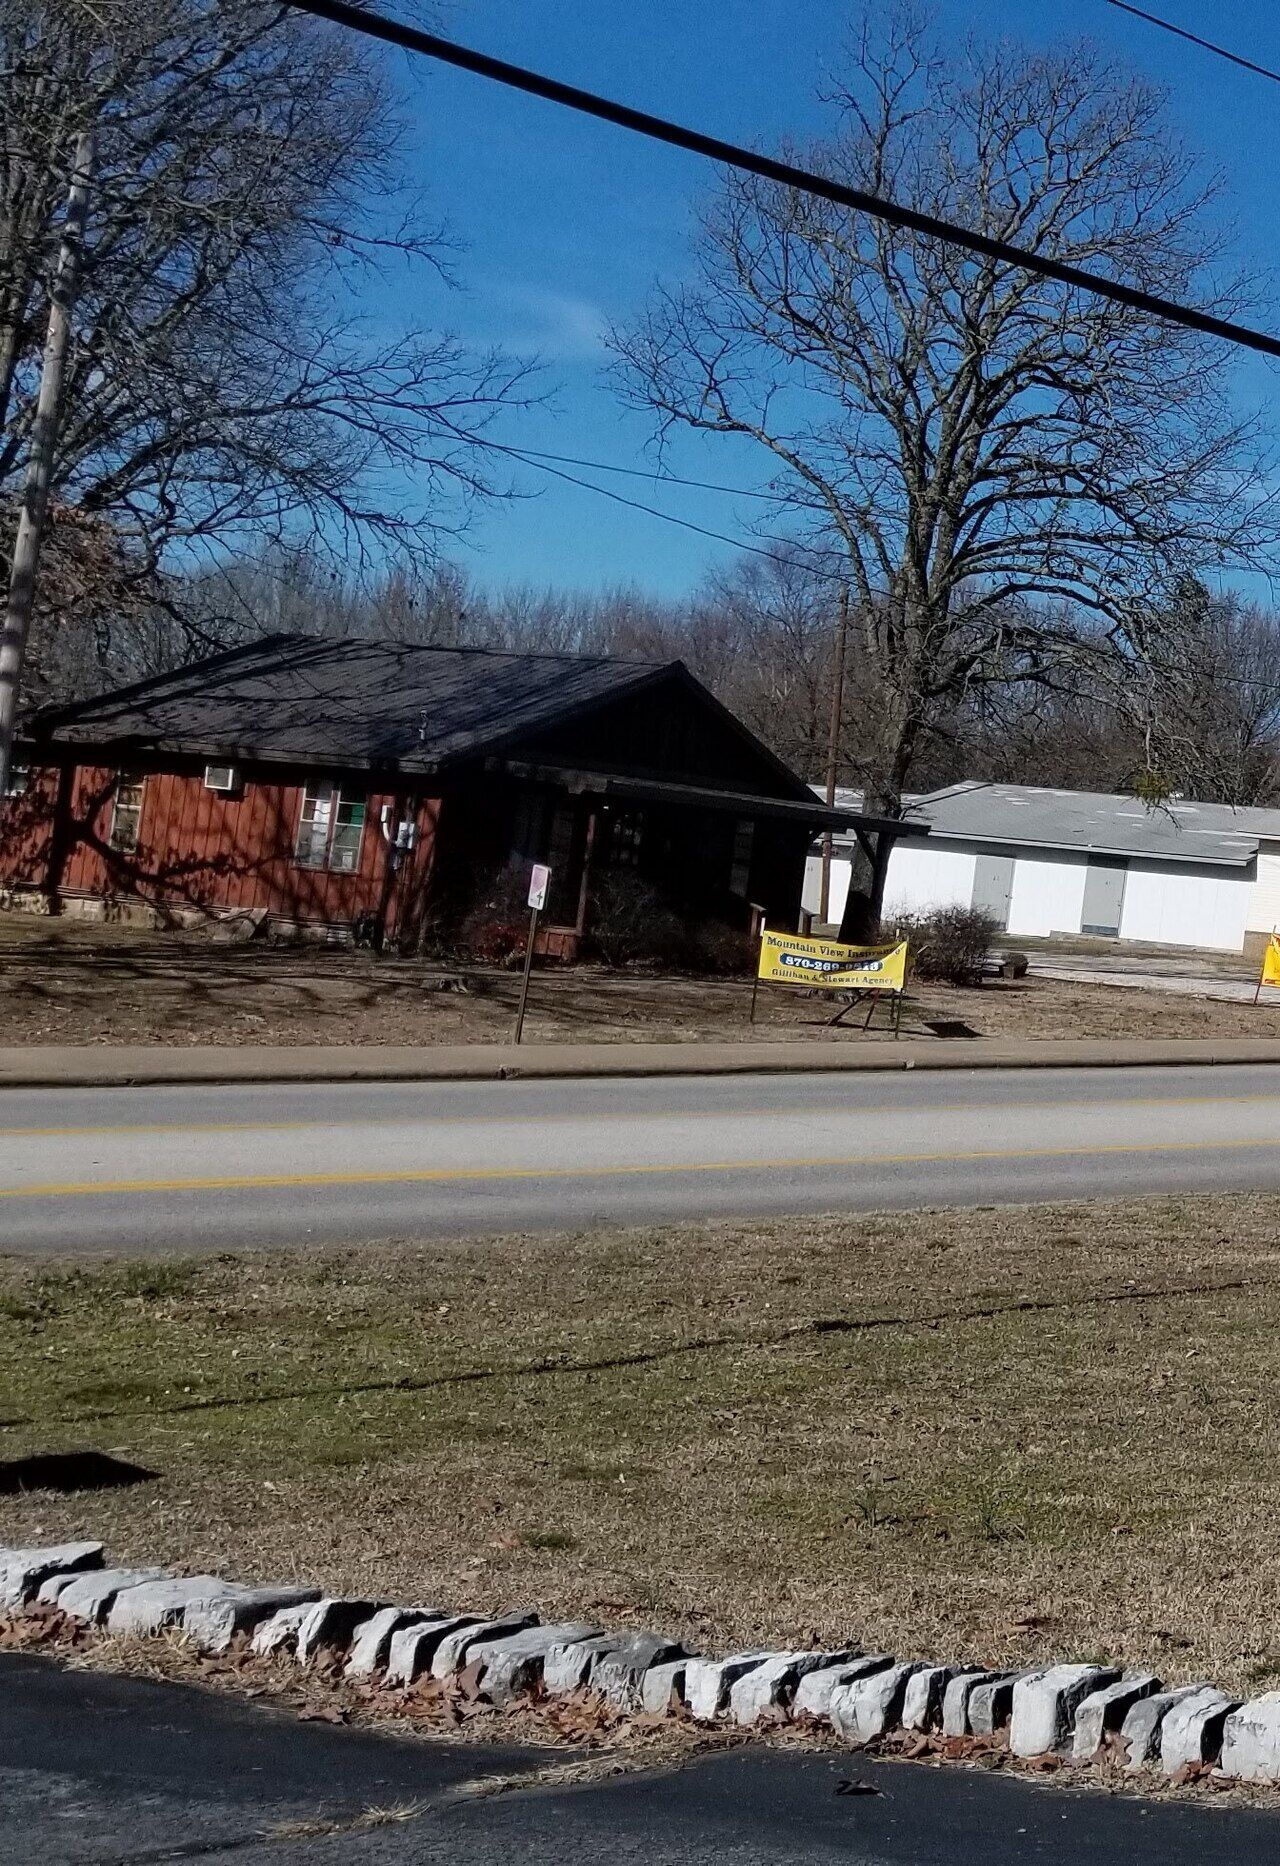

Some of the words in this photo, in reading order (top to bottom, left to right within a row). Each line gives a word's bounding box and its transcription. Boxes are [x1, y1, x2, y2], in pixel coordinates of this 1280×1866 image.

[767, 936, 816, 954] Mountain
[820, 945, 845, 957] View
[772, 968, 809, 981] Gillihan
[822, 973, 859, 984] Stewart
